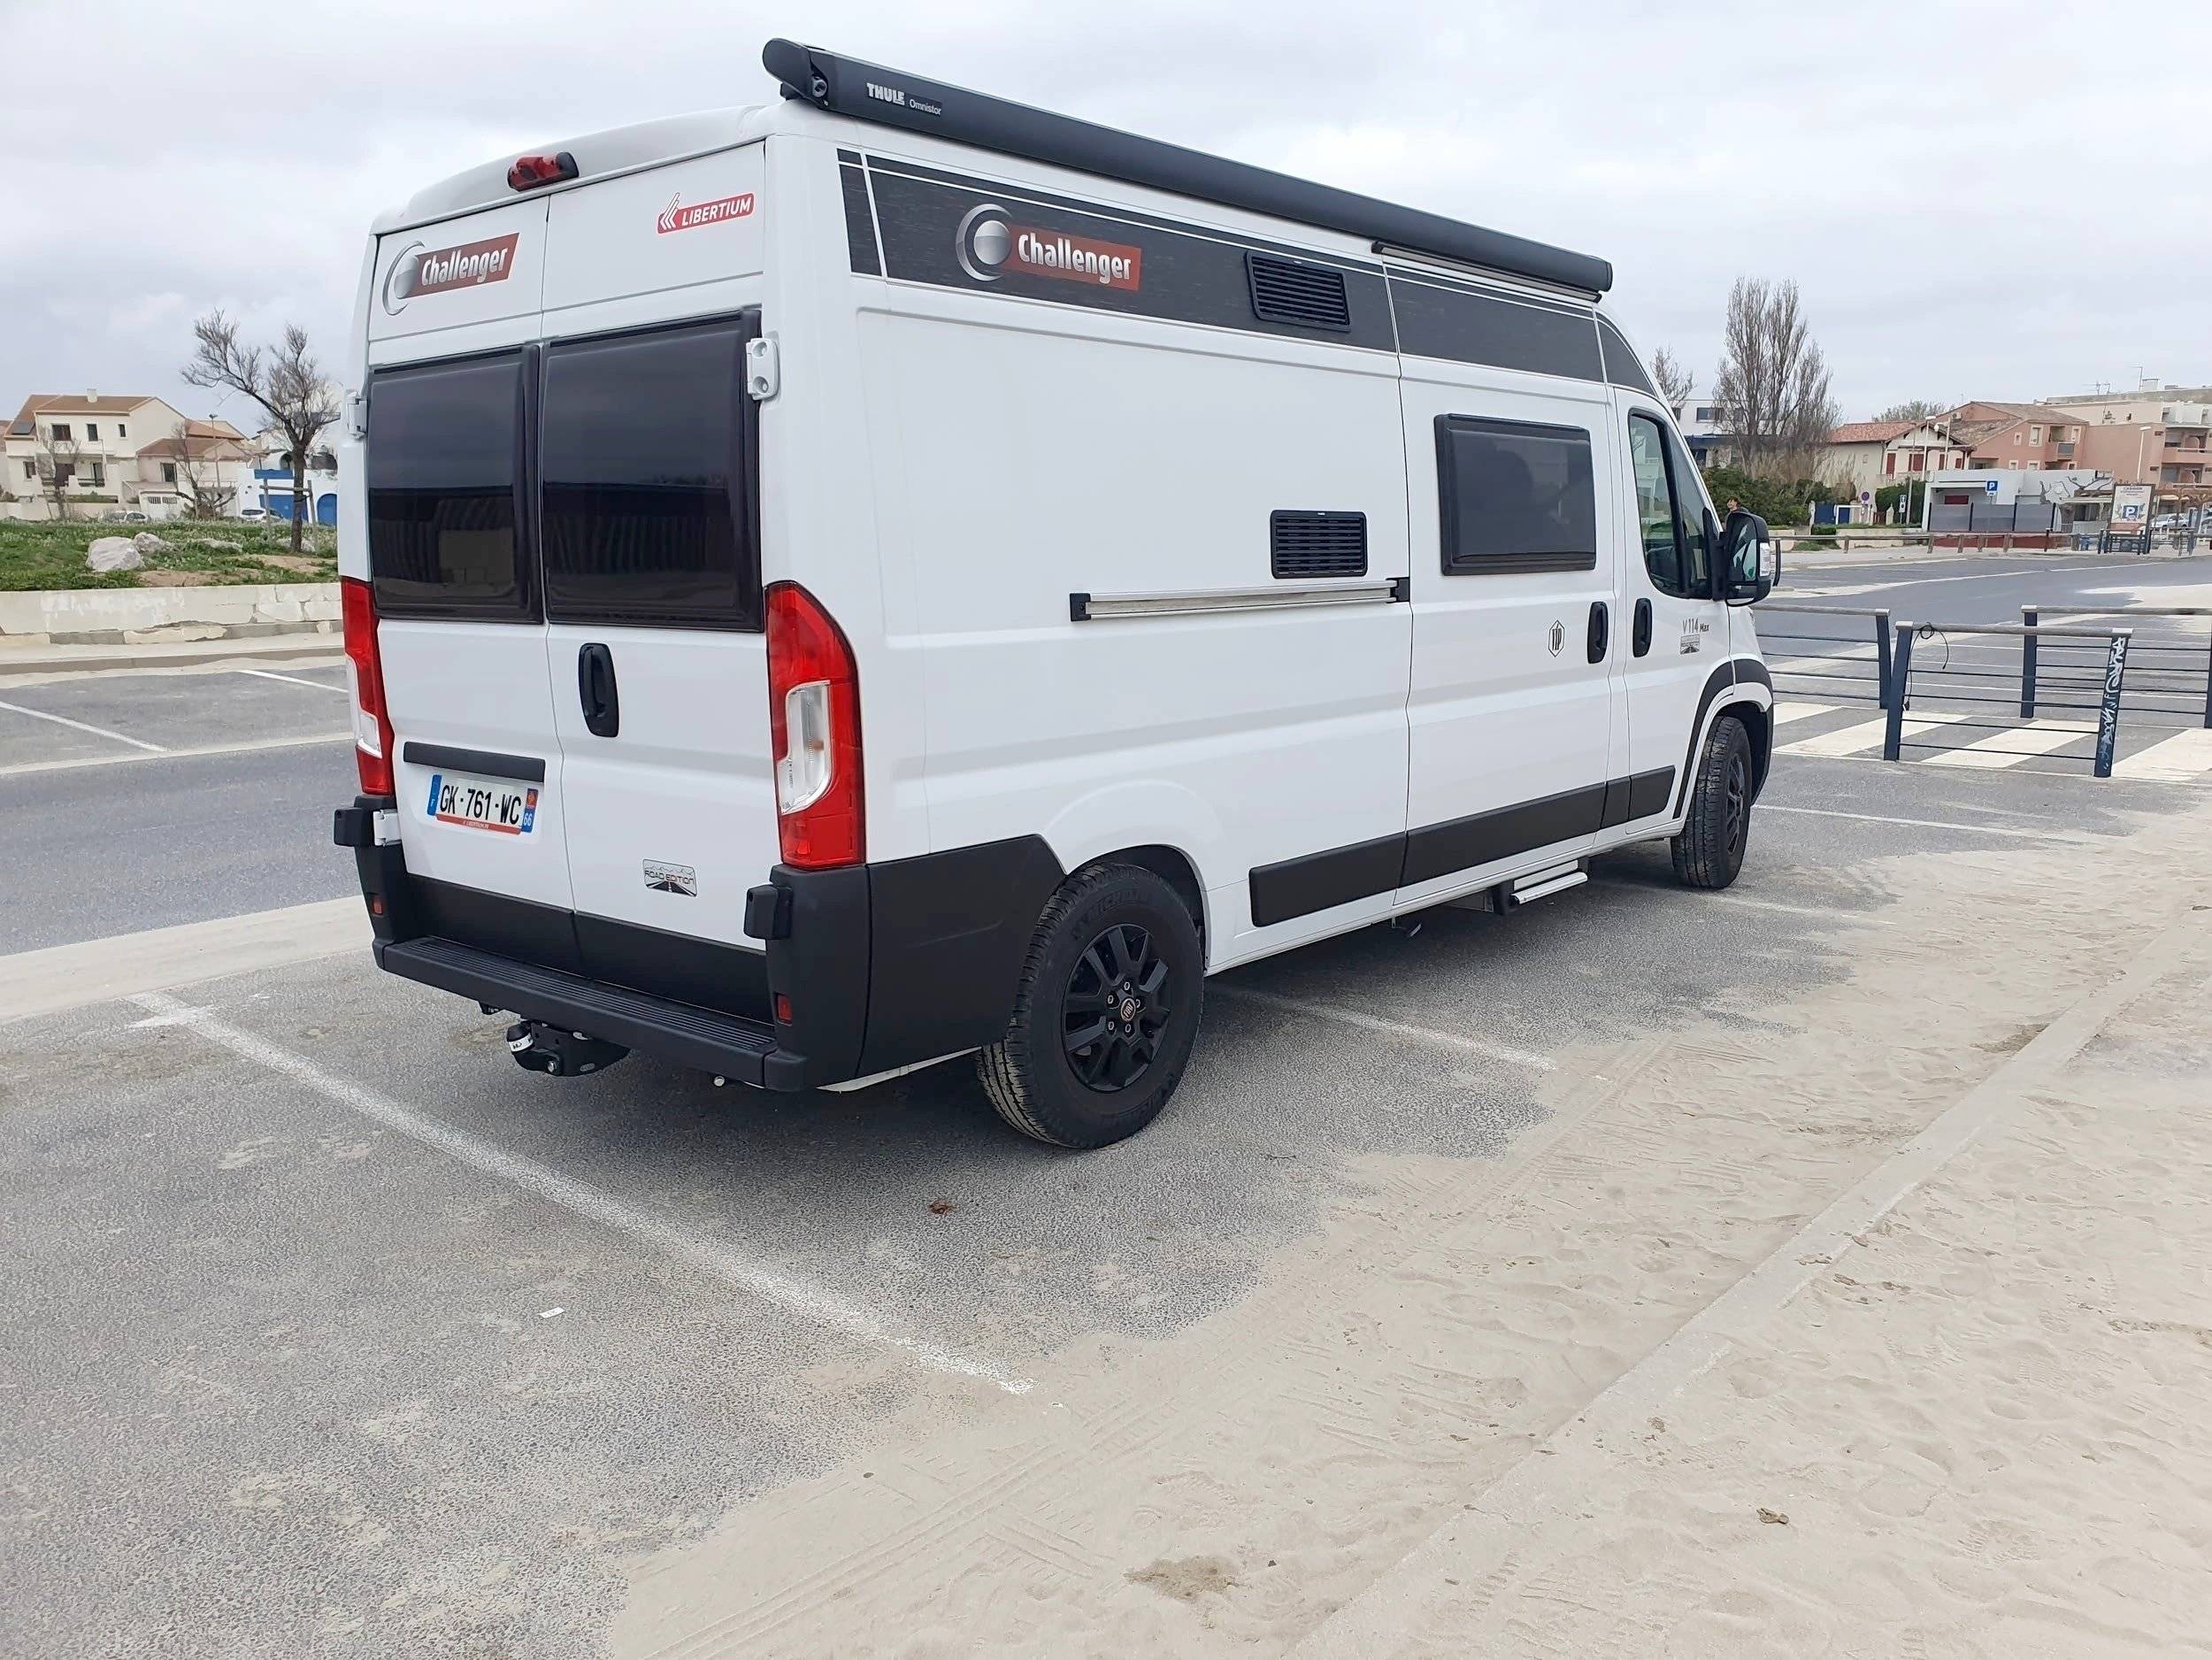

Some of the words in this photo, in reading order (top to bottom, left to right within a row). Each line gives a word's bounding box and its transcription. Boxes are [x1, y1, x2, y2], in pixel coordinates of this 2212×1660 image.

[867, 82, 905, 105] THULE
[909, 98, 942, 115] Omnistor
[681, 196, 752, 227] LIBERTIUM
[421, 248, 509, 286] Challenger
[1018, 232, 1132, 284] Challenger
[523, 812, 534, 826] 66
[644, 870, 665, 880] ROAD
[665, 873, 695, 885] EDITION
